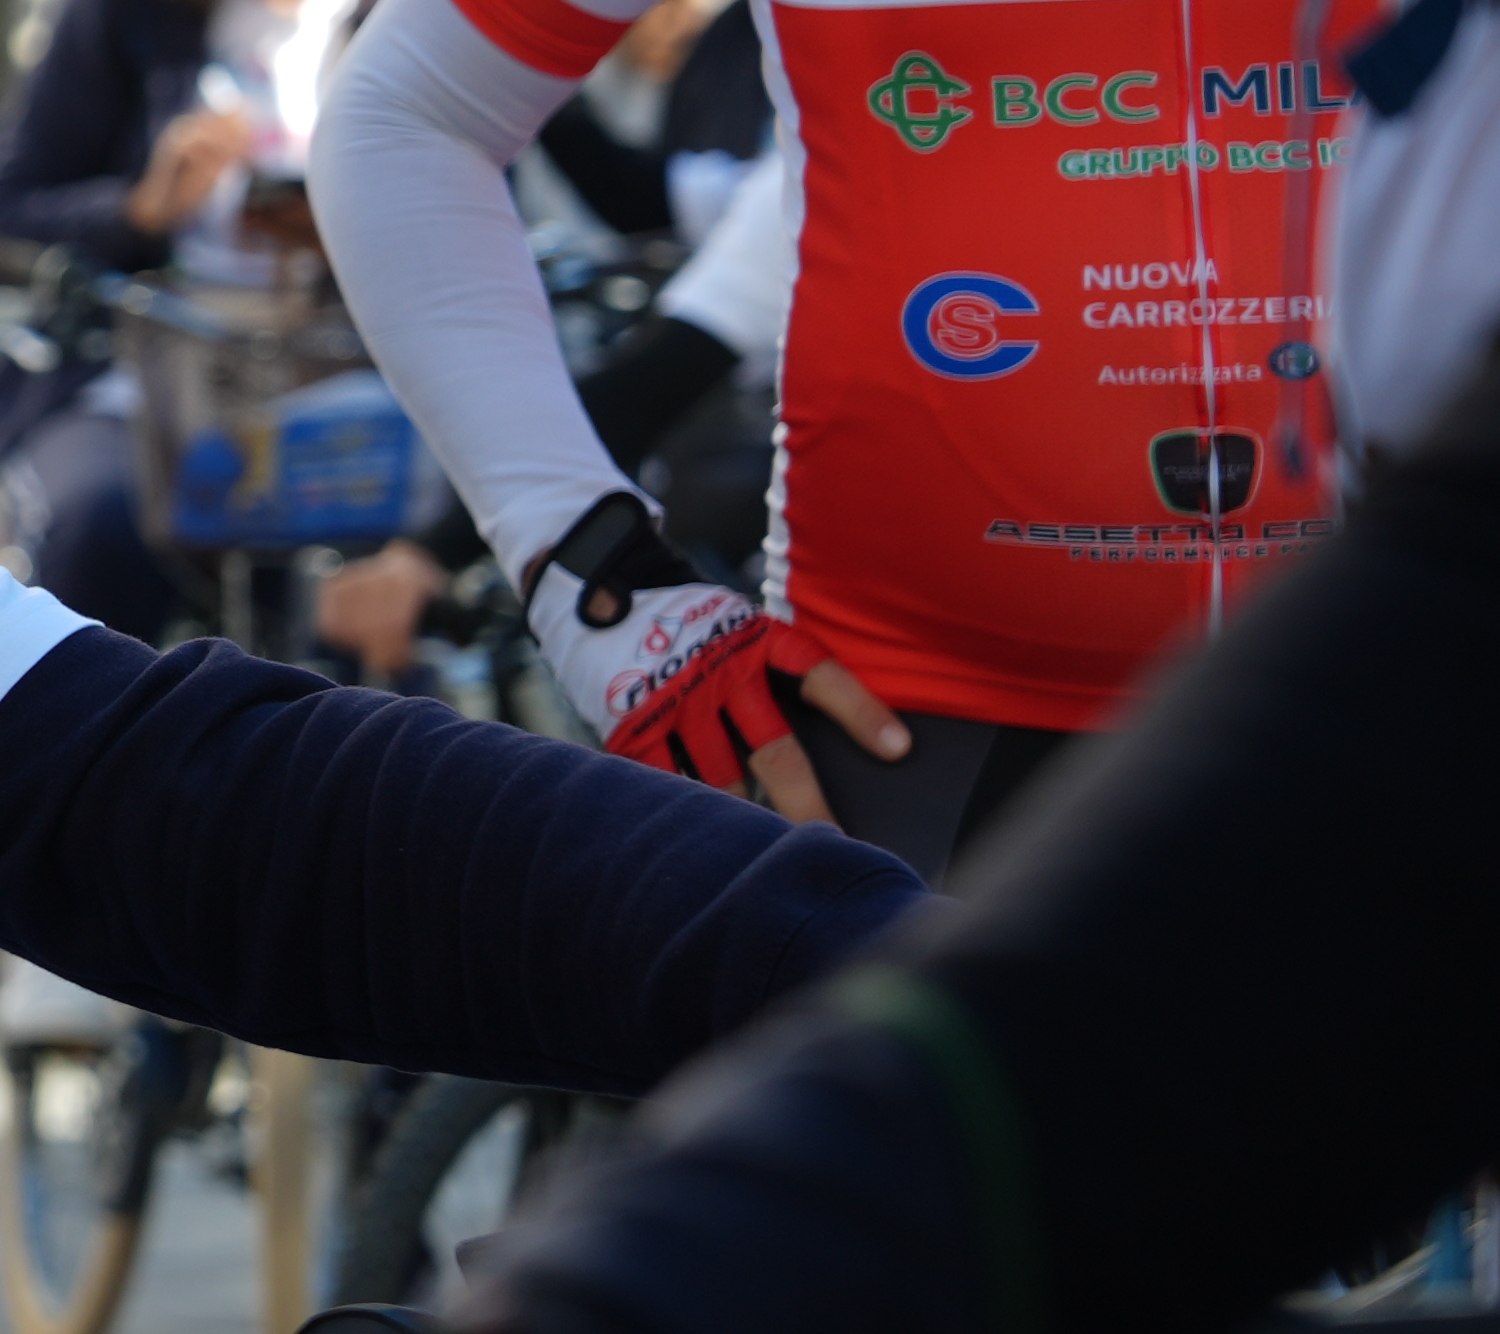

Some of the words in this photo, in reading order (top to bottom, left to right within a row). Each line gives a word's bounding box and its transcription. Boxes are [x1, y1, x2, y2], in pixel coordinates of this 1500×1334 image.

[991, 71, 1160, 128] BCC
[1058, 140, 1219, 181] GRUPPO
[1227, 140, 1311, 172] BCC
[1082, 259, 1220, 291] NUOVA
[1098, 362, 1264, 386] Autorizzata
[984, 518, 1244, 546] ASSETTO
